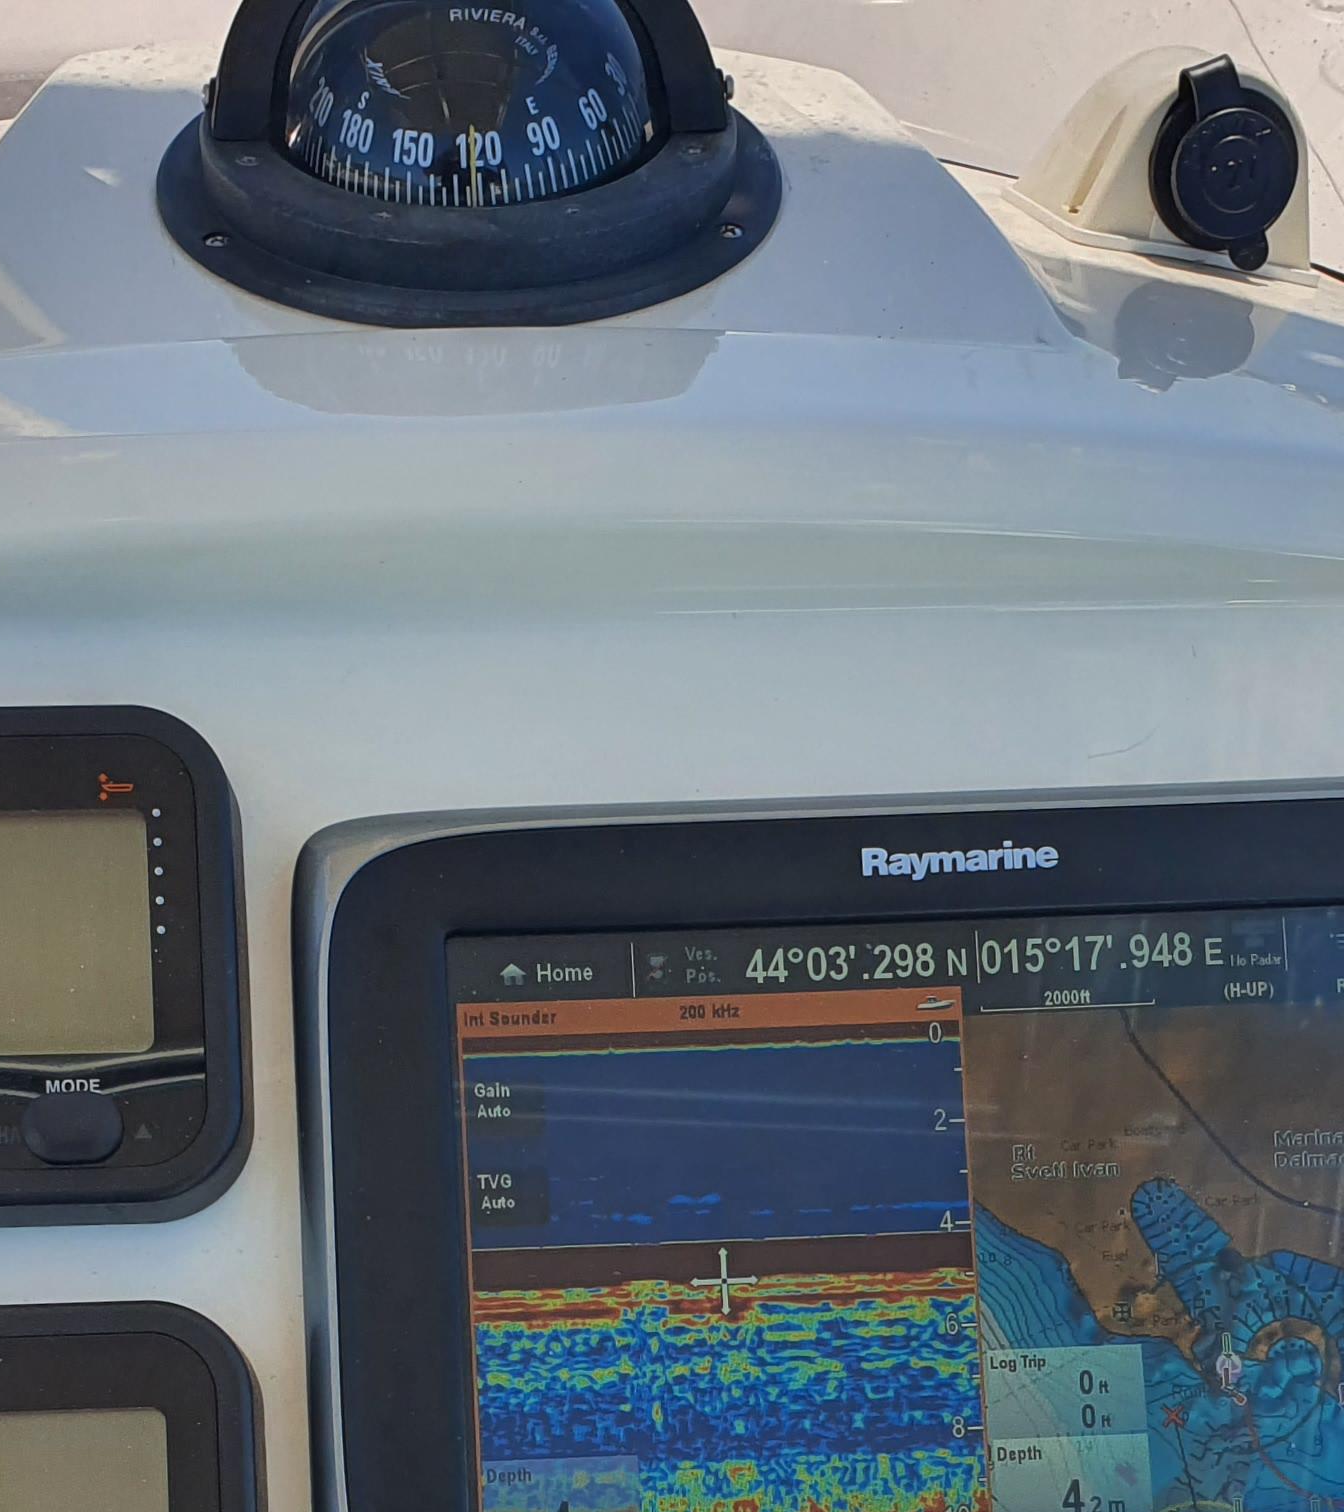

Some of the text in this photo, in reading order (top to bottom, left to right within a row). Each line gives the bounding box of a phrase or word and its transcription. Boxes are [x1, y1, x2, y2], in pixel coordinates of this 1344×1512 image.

[449, 7, 526, 30] RIVIERA
[309, 76, 334, 127] 210
[358, 91, 370, 109] S
[525, 96, 539, 115] E
[578, 88, 608, 130] 60
[339, 108, 375, 154] 180
[526, 115, 561, 156] 90
[392, 129, 434, 168] 150
[455, 131, 502, 169] 120
[861, 840, 1059, 881] Raymarine
[947, 948, 968, 976] N
[1204, 937, 1224, 966] E
[536, 963, 593, 983] Home
[1043, 989, 1091, 1006] 2000ft
[1223, 981, 1275, 1001] (H-UP)
[463, 1003, 740, 1028] Int Sounder 200 kHz
[928, 1021, 942, 1044] 0
[45, 1078, 101, 1094] MODE
[474, 1082, 510, 1098] Gain
[477, 1104, 511, 1118] Auto
[933, 1109, 948, 1131] 2
[477, 1173, 512, 1190] TVG
[482, 1195, 515, 1210] Auto
[938, 1211, 954, 1233] 4
[943, 1313, 959, 1336] 6
[989, 1354, 1046, 1373] Log Trip
[1079, 1369, 1094, 1395] 0
[1081, 1403, 1096, 1429] 0
[950, 1416, 966, 1439] 8
[996, 1446, 1043, 1465] Depth
[486, 1467, 532, 1486] Depth
